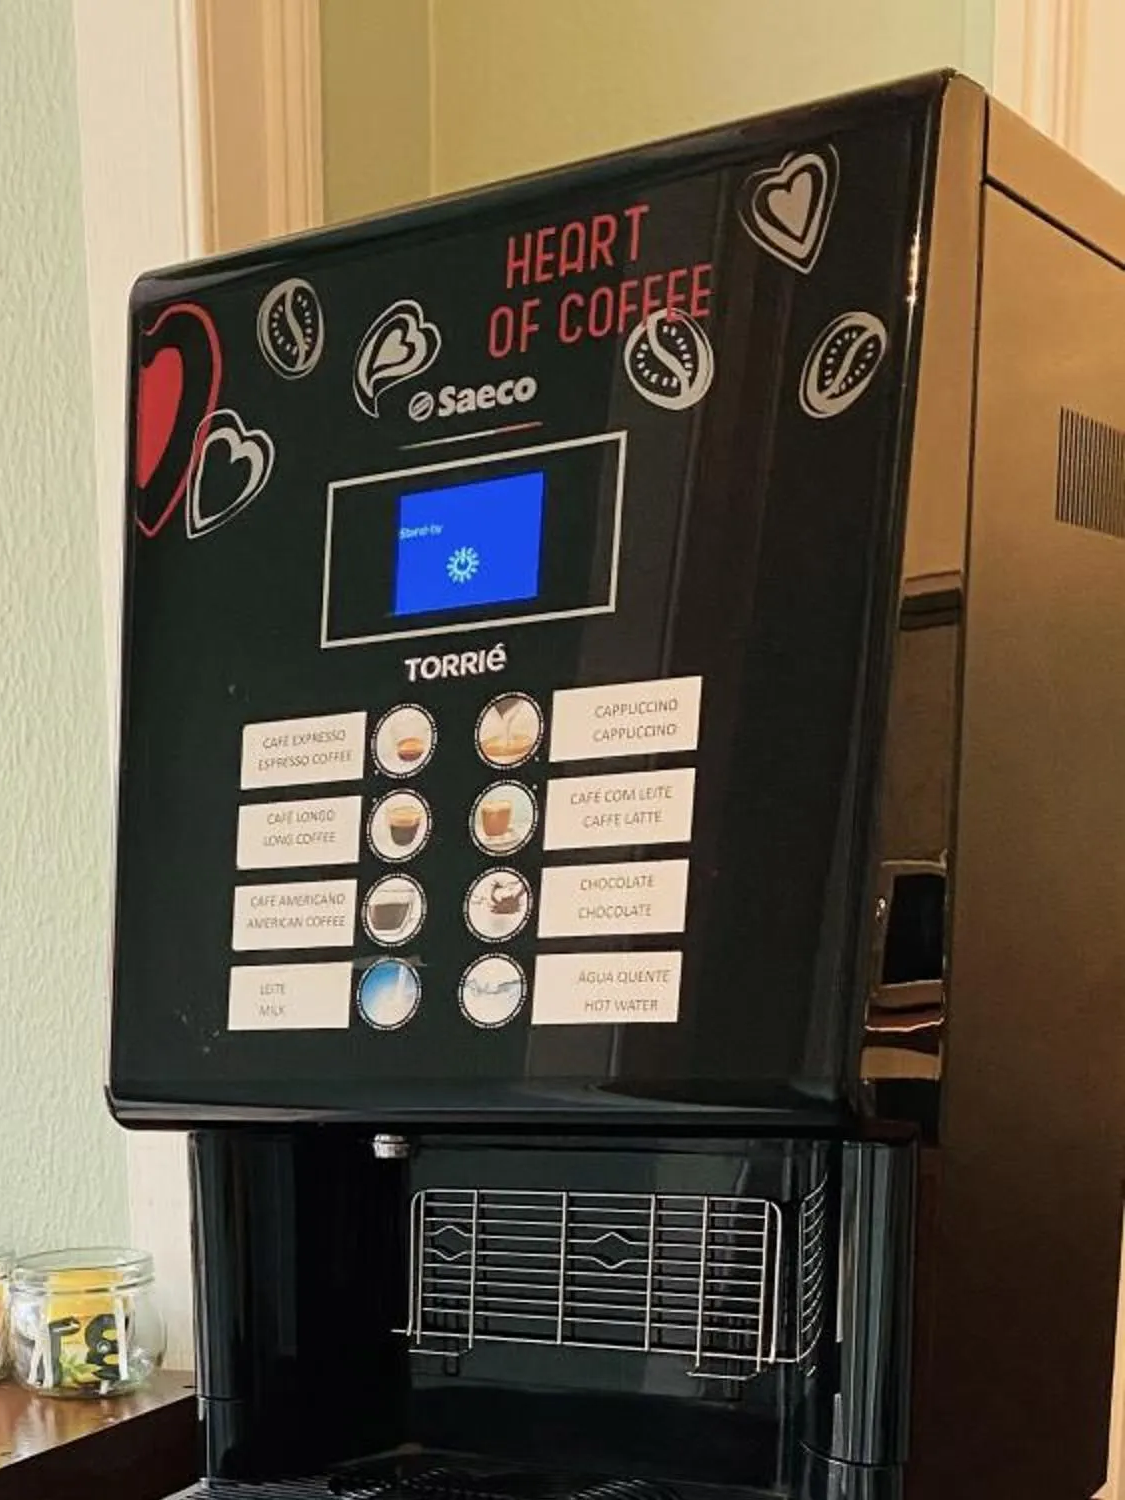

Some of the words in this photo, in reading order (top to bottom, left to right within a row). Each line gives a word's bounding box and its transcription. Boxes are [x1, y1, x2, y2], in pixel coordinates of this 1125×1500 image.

[505, 204, 650, 289] HEART
[488, 298, 541, 359] OF
[558, 263, 713, 344] COFFEE
[438, 376, 537, 417] Saeco
[594, 698, 678, 718] CAPPUCCINO
[292, 729, 347, 747] EXPRESSO
[592, 723, 677, 742] CAPPUCCINO
[258, 754, 309, 771] ESPRESSO
[312, 750, 352, 765] COFFEE
[604, 788, 636, 803] COM
[639, 785, 673, 801] LEITE
[296, 809, 336, 823] LONGO
[624, 810, 664, 825] LATTE
[263, 833, 293, 846] LONG
[296, 831, 336, 844] COFFEE
[580, 874, 654, 891] CHOCOLATE
[279, 892, 346, 907] AMERICANO
[578, 903, 652, 919] CHOCOLATE
[247, 916, 303, 929] AMERICAN
[305, 914, 346, 927] COFFEE
[617, 969, 671, 984] QUENTE
[585, 1000, 611, 1012] HOT
[614, 999, 658, 1012] WATER
